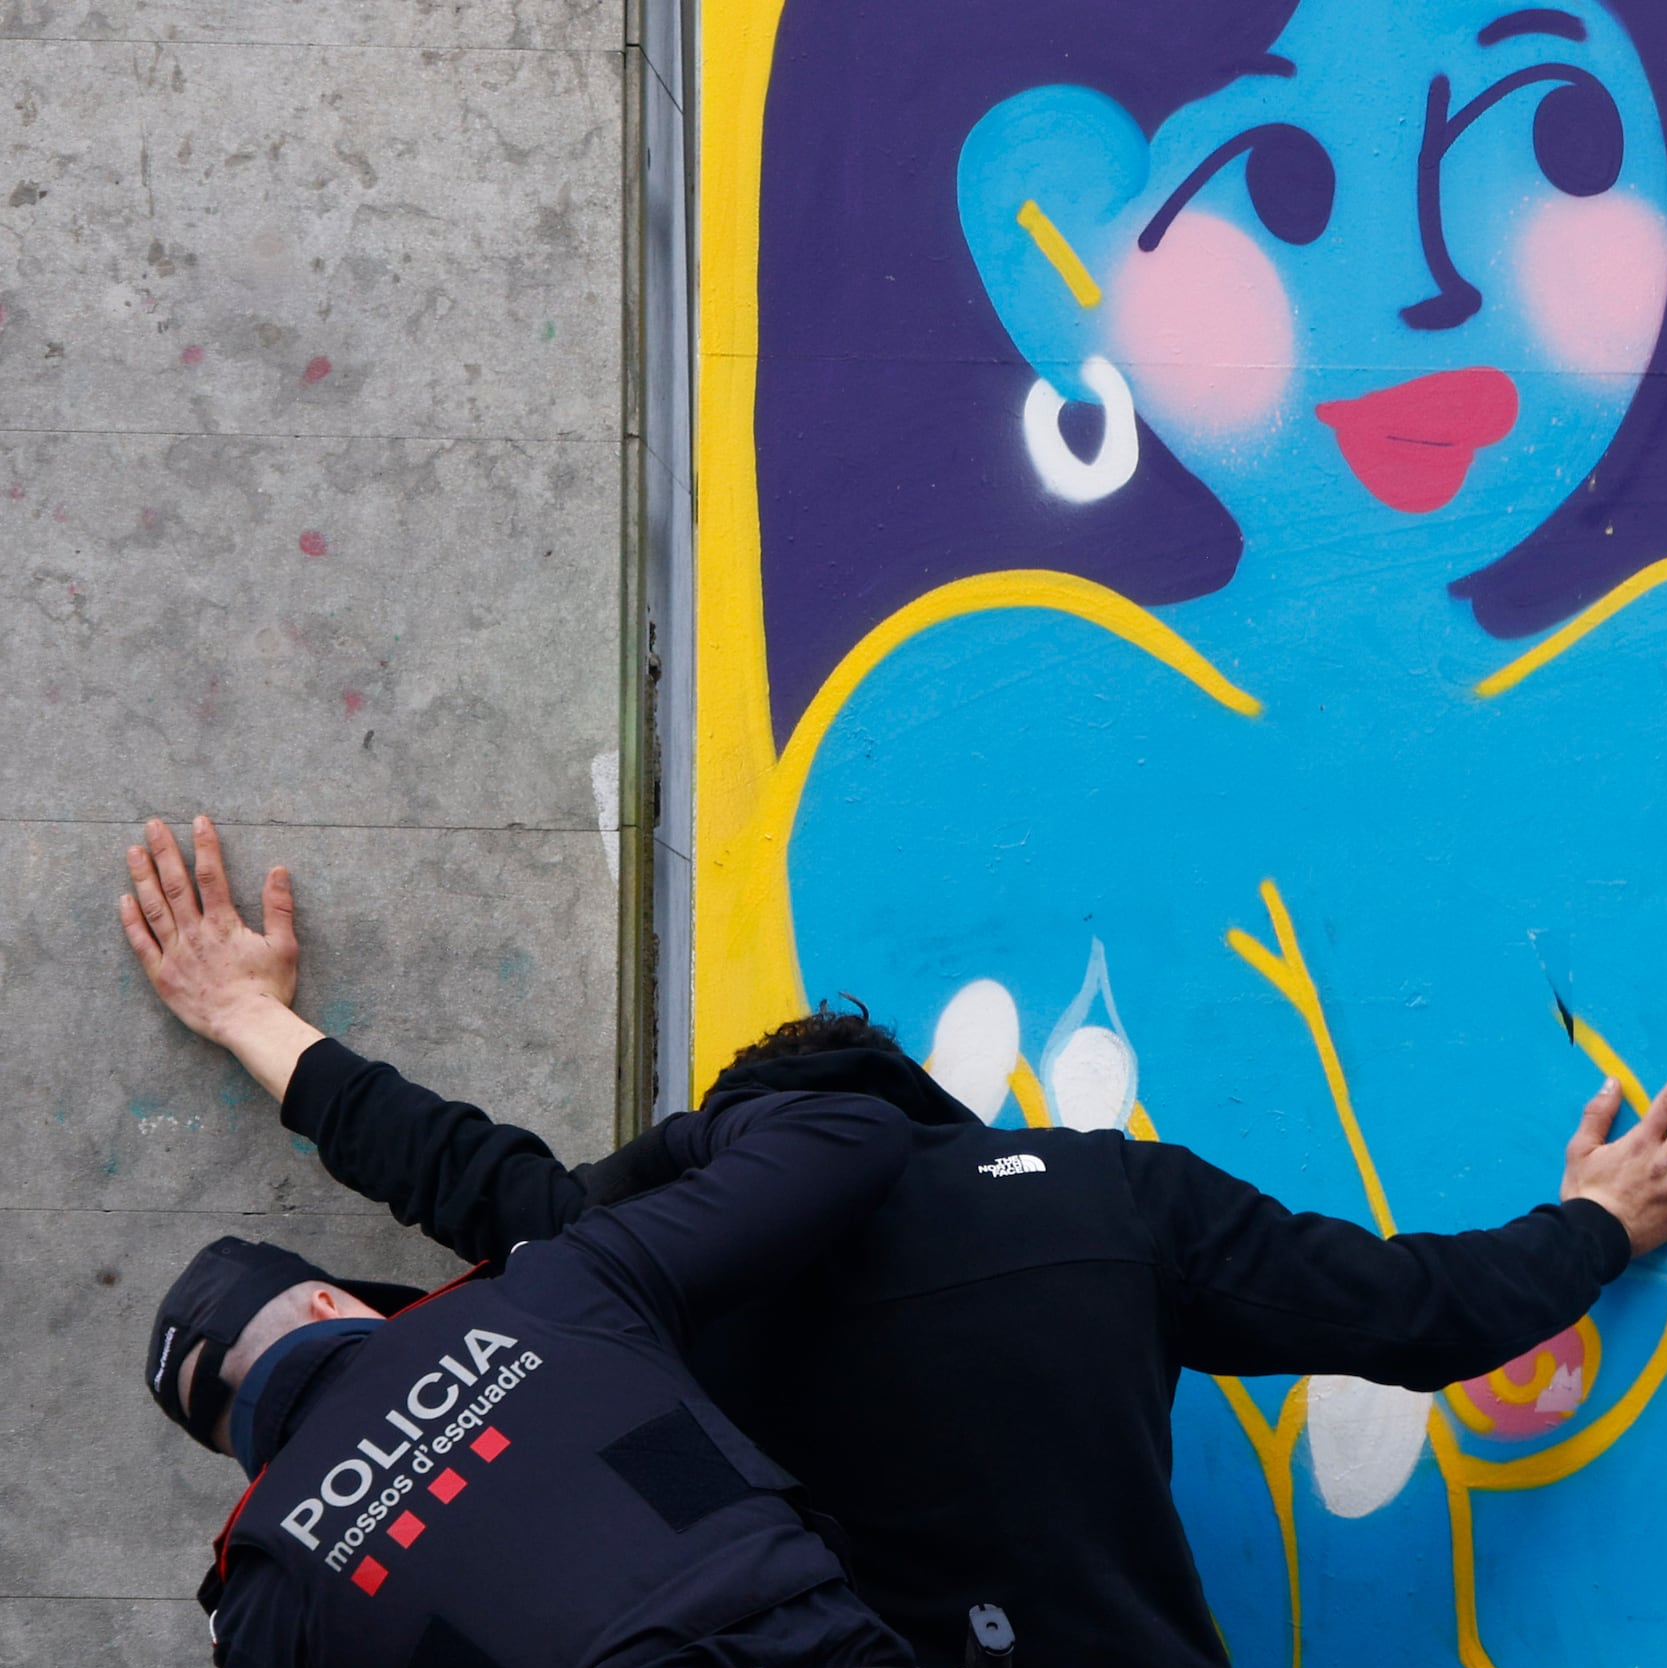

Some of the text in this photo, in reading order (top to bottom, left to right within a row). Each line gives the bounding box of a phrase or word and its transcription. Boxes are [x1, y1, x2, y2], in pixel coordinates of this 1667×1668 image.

[992, 1166, 1024, 1178] FACE
[994, 1155, 1020, 1165] THE
[279, 1328, 518, 1551] POLICIA
[324, 1350, 543, 1573] mossos d'esquadra
